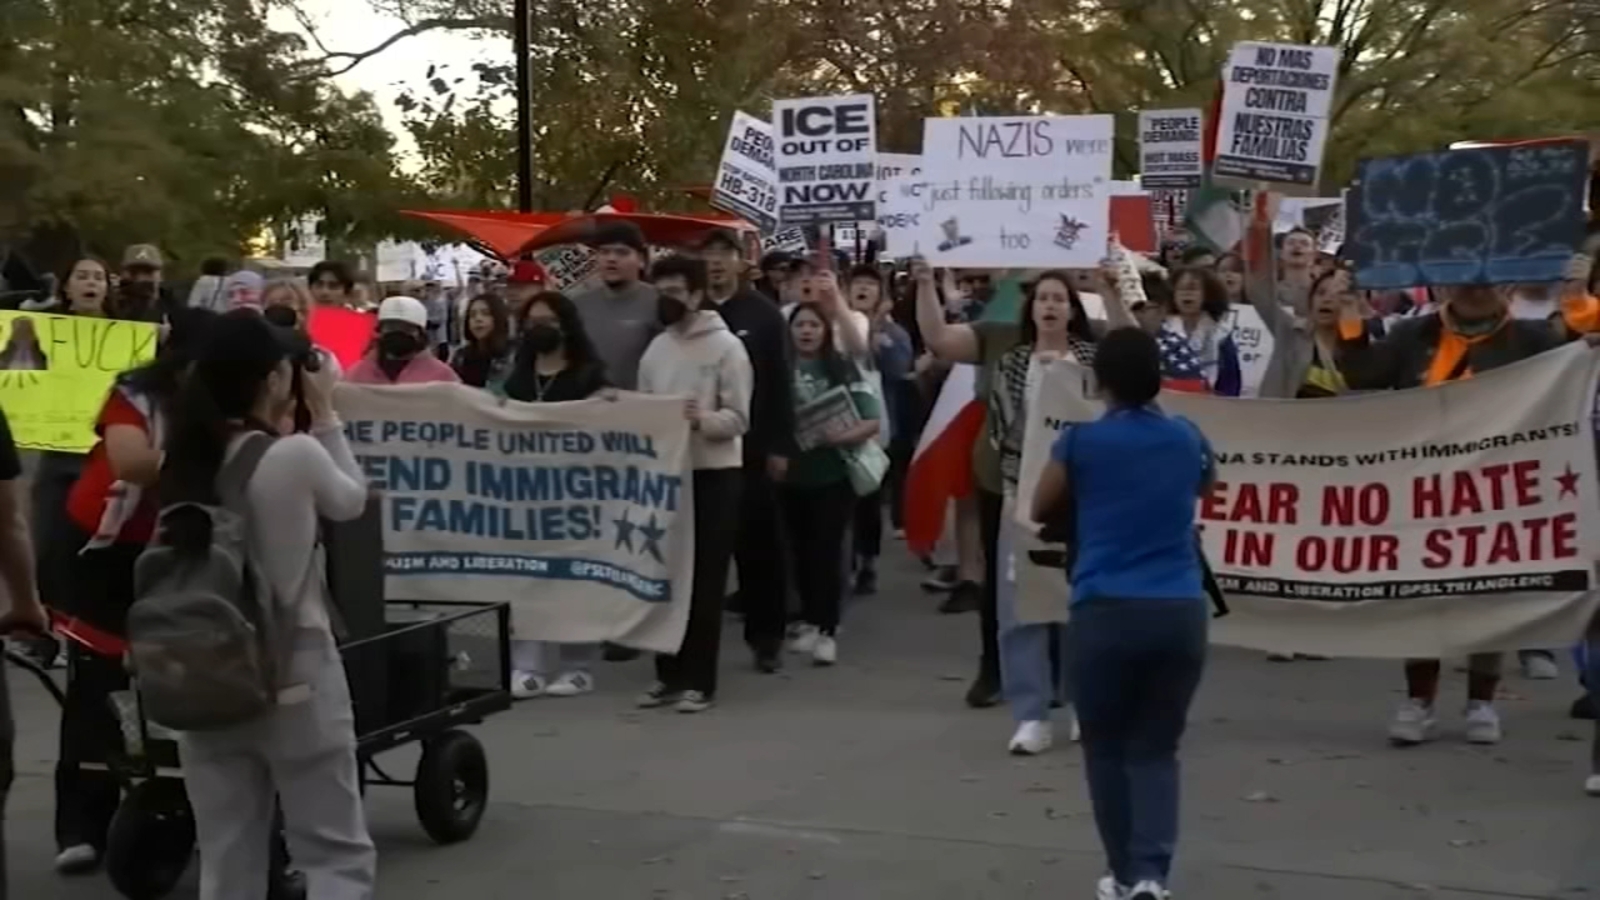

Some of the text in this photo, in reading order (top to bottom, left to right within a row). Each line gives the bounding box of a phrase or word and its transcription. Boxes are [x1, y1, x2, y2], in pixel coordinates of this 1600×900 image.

[1255, 47, 1275, 67] NO
[1231, 66, 1330, 90] DEPORTACIONES
[1245, 88, 1307, 113] CONTRA
[782, 104, 870, 137] ICE
[1151, 117, 1199, 130] PEOPLE
[1234, 112, 1313, 140] NUESTRAS
[743, 126, 774, 153] PEO
[781, 138, 869, 156] OUT OF
[958, 120, 1108, 160] NAZIS were
[1230, 134, 1307, 161] FAMILIAS
[719, 172, 776, 213] HB-318
[785, 182, 870, 203] NOW
[970, 176, 1031, 214] following
[764, 227, 801, 250] ARE
[1000, 225, 1030, 250] too
[49, 316, 156, 372] FUCK
[345, 420, 658, 460] HE PEOPLE UNITED WILL
[1252, 453, 1349, 468] STANDS
[1356, 447, 1418, 466] WITH
[1422, 422, 1580, 459] IMMIGRANTS!
[364, 454, 682, 511] END IMMIGRANT
[1200, 459, 1544, 527] EAR NO HATE
[393, 497, 603, 541] FAMILIES!
[1223, 512, 1580, 574] IN OUR STATE
[428, 555, 461, 569] AND
[464, 555, 548, 571] LIBERATION
[1244, 580, 1279, 592] AND
[1284, 581, 1386, 599] LIBERATION
